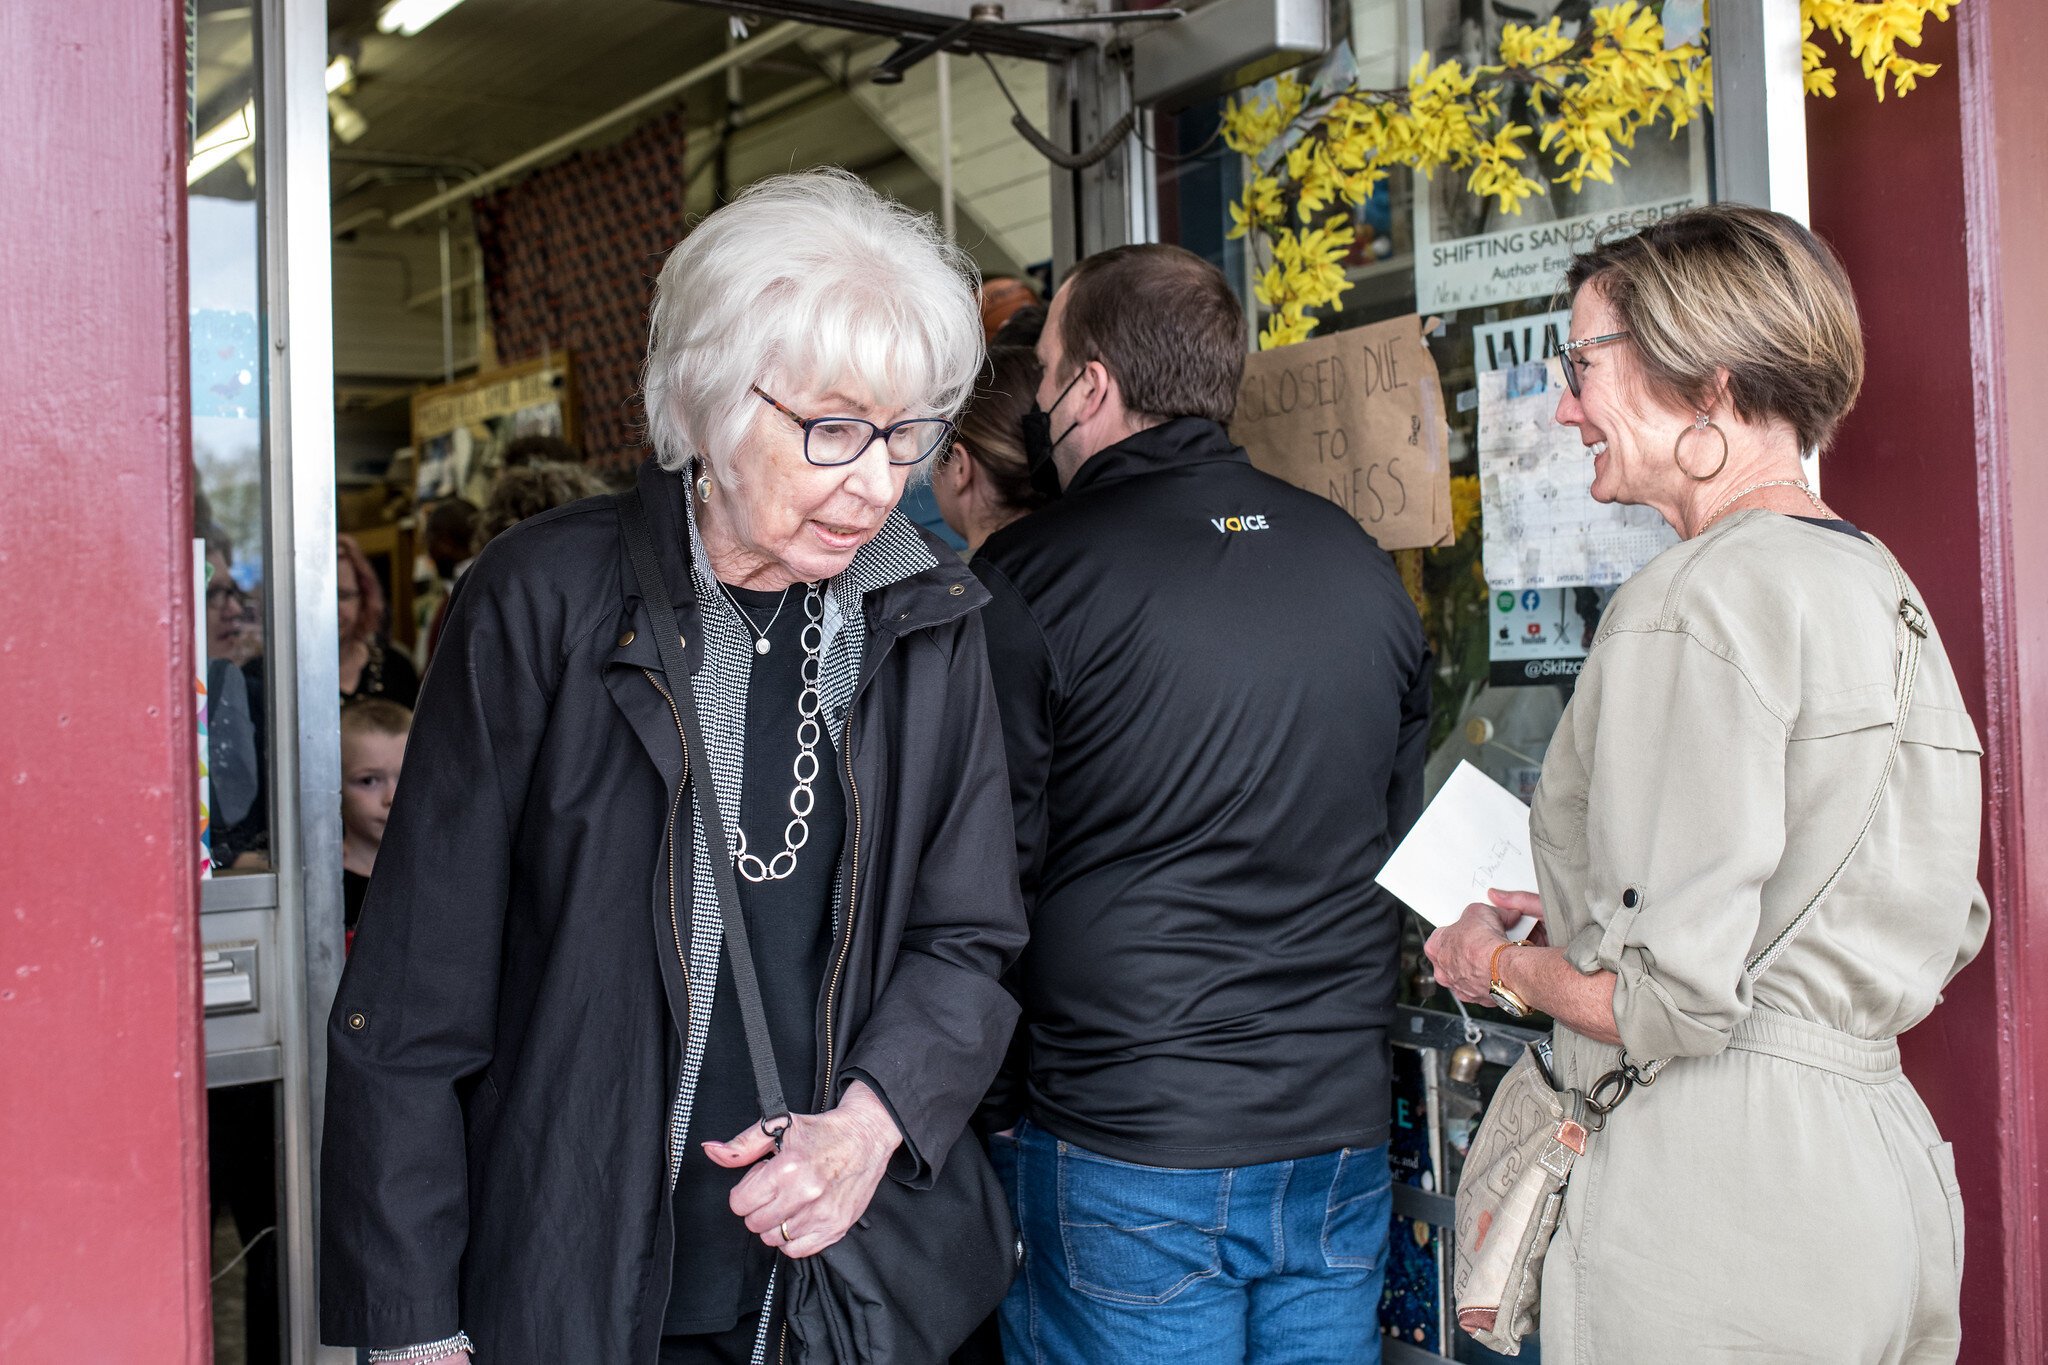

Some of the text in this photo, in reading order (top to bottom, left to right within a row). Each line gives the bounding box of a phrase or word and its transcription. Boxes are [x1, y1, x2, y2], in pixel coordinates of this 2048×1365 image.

[1432, 230, 1525, 267] SHIFTING
[1492, 263, 1539, 281] Author
[1244, 336, 1408, 423] CLOSED DUE
[1312, 427, 1349, 464] TO
[1210, 514, 1270, 534] VOICE
